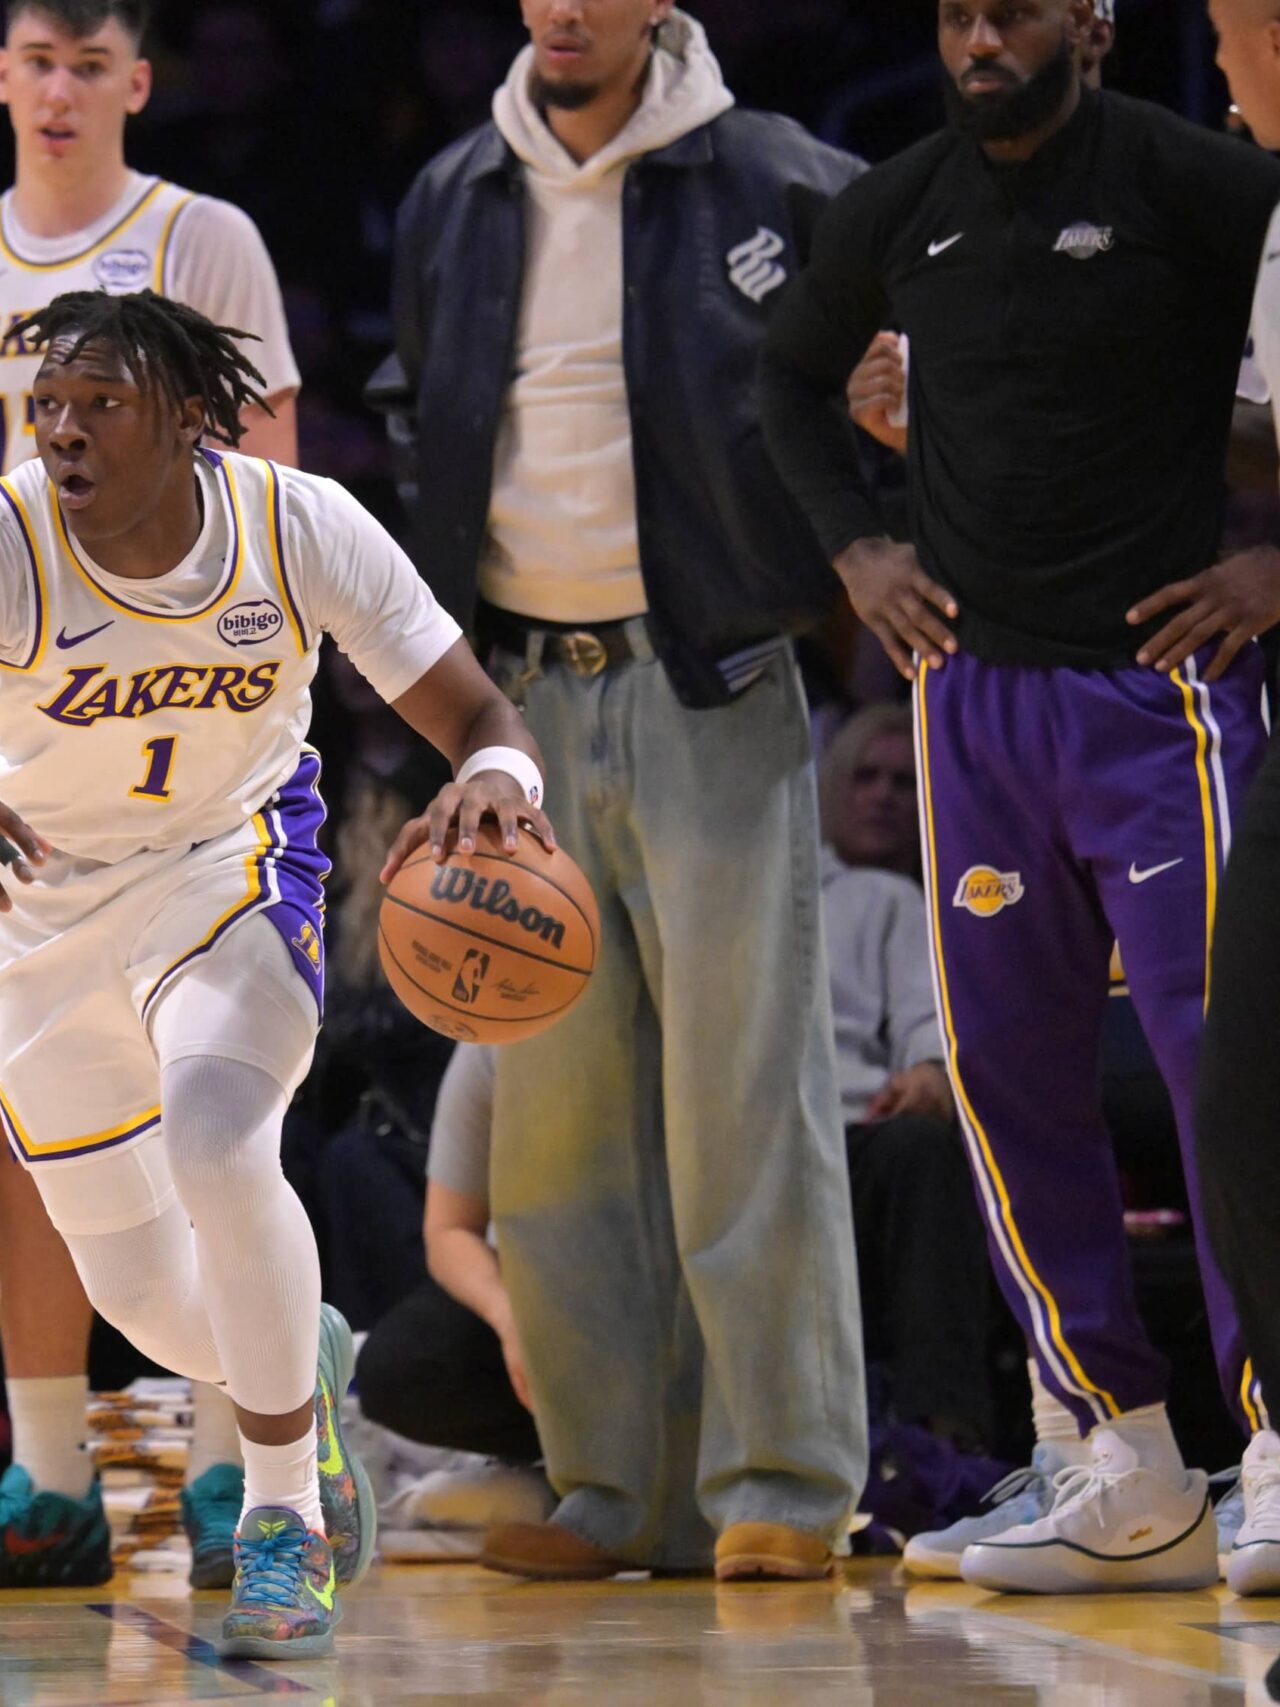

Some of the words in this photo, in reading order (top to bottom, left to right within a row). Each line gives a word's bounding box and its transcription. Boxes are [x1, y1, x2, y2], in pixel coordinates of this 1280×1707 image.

[223, 612, 279, 630] bibigo
[34, 660, 283, 728] LAKERS
[127, 733, 180, 803] 1
[430, 864, 566, 949] Wilson
